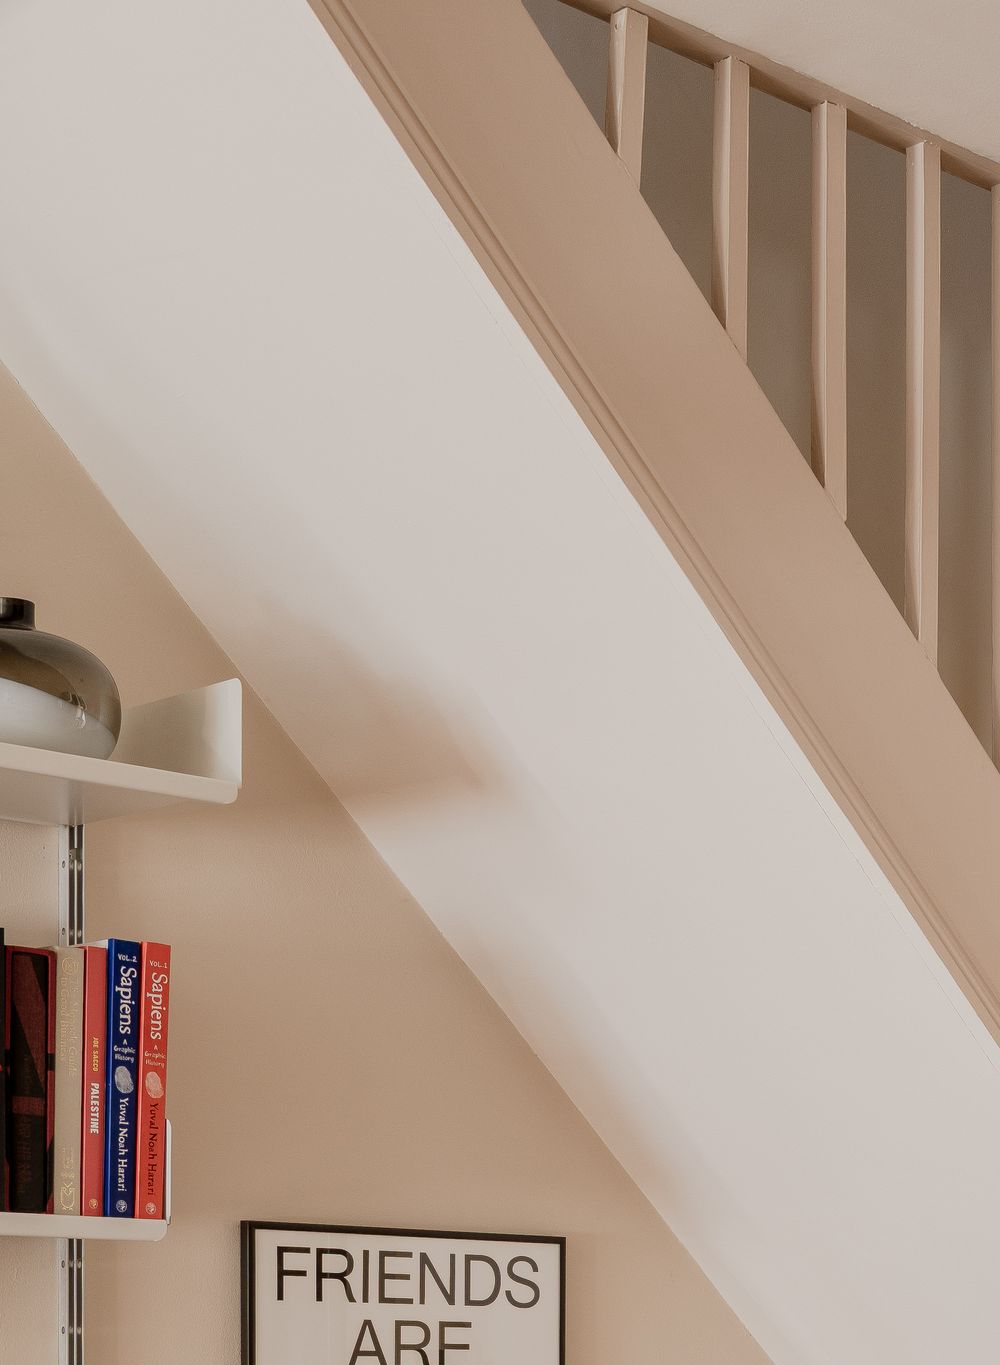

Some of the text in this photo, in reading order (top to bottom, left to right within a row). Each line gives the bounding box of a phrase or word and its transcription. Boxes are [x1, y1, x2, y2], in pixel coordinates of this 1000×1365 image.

[115, 966, 138, 1035] Sapiens
[147, 972, 168, 1040] Sapiens
[113, 1045, 136, 1054] Graphic
[144, 1051, 166, 1060] Graphic
[90, 1082, 100, 1134] PALESTINE
[117, 1097, 129, 1192] Yuval Noah Harari
[147, 1103, 159, 1196] Yuval Noah Harari
[276, 1245, 541, 1309] FRIENDS
